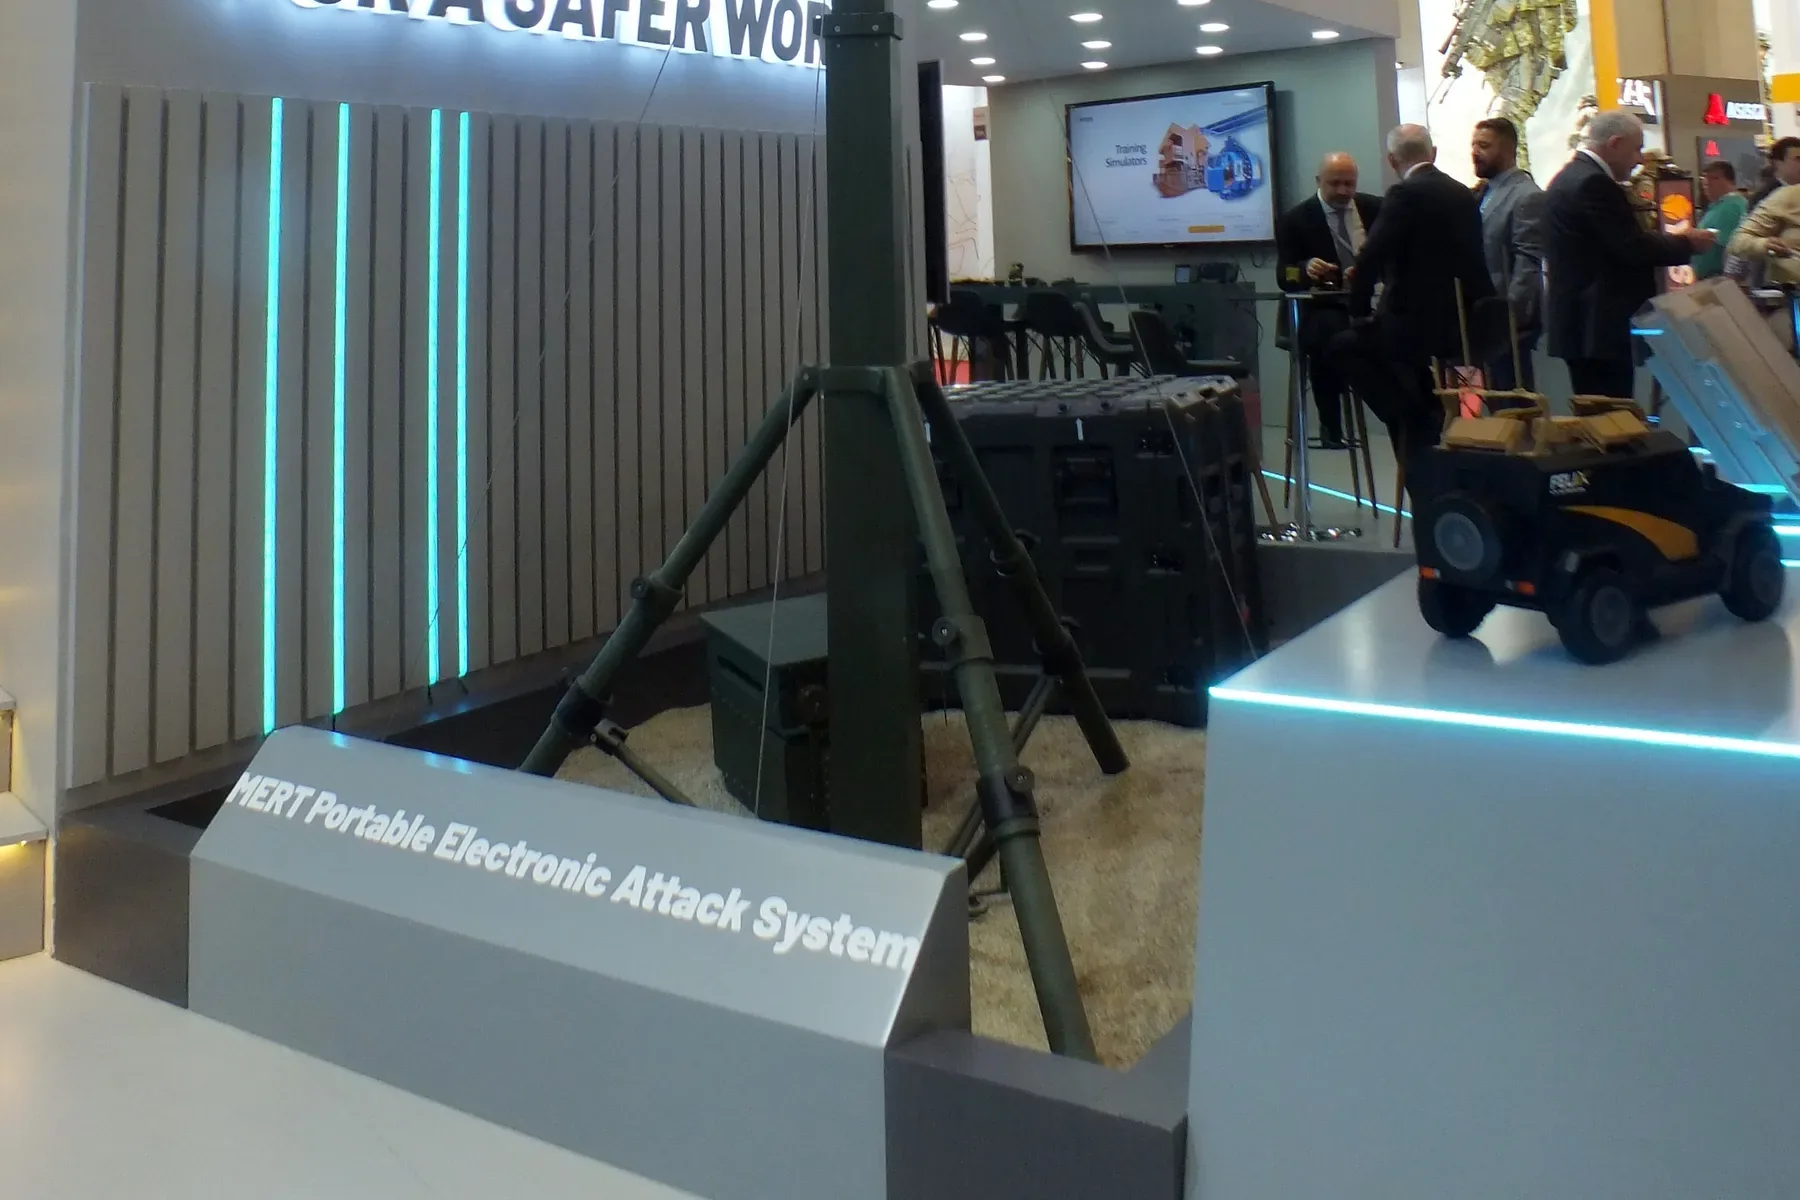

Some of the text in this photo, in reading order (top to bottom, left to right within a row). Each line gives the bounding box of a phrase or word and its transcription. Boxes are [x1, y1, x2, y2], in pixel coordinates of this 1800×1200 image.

[1114, 143, 1148, 155] Training
[1105, 156, 1148, 169] Simulators
[226, 771, 922, 972] MERT Portable Electronic Attack System
